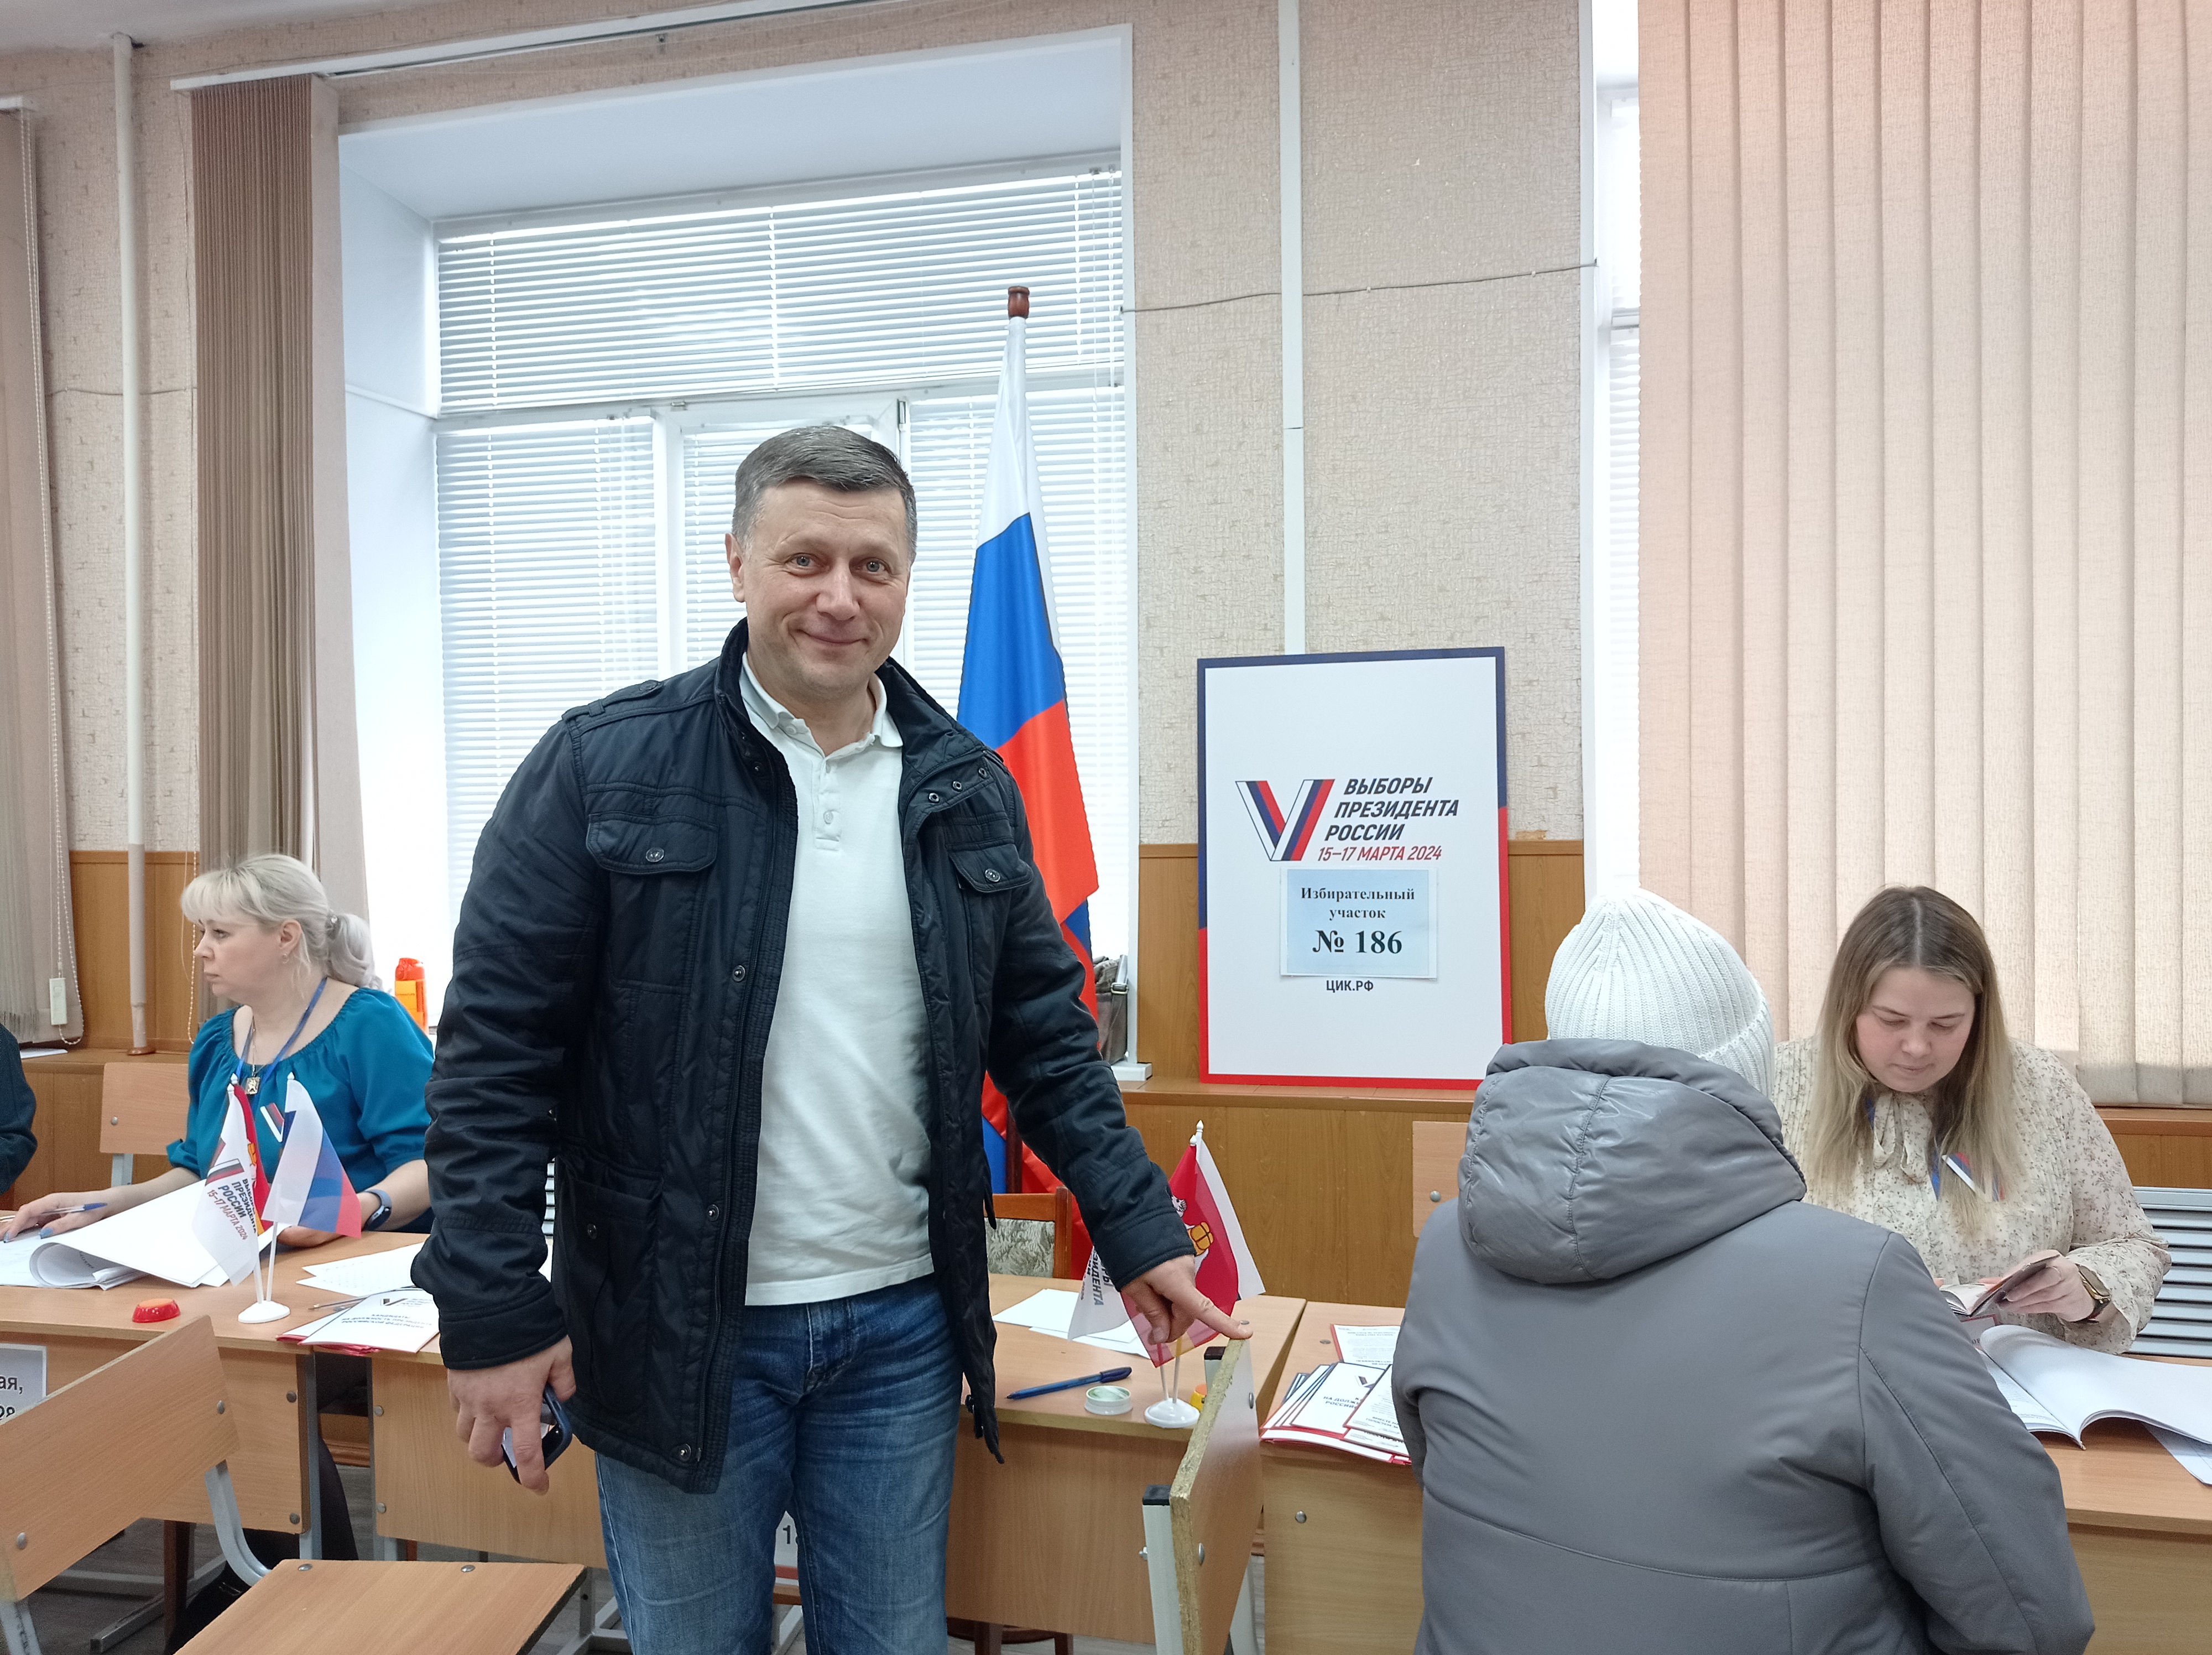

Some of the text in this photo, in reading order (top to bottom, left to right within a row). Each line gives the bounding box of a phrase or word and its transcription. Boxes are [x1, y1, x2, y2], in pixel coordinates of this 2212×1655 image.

[1344, 777, 1433, 795] ВЫБОРЫ
[1334, 800, 1459, 819] ПРЕЗИДЕНТА
[1324, 824, 1405, 841] РОССИИ
[1357, 846, 1405, 861] МАРТА
[1407, 845, 1442, 860] 2024
[1301, 887, 1415, 902] Избирательный
[1329, 909, 1386, 921] участок
[1312, 930, 1402, 954] № 186
[1326, 980, 1374, 993] ЦИК.РФ
[218, 1185, 248, 1219] РОССИИ
[220, 1204, 240, 1226] МАРТА
[235, 1225, 248, 1240] 2024
